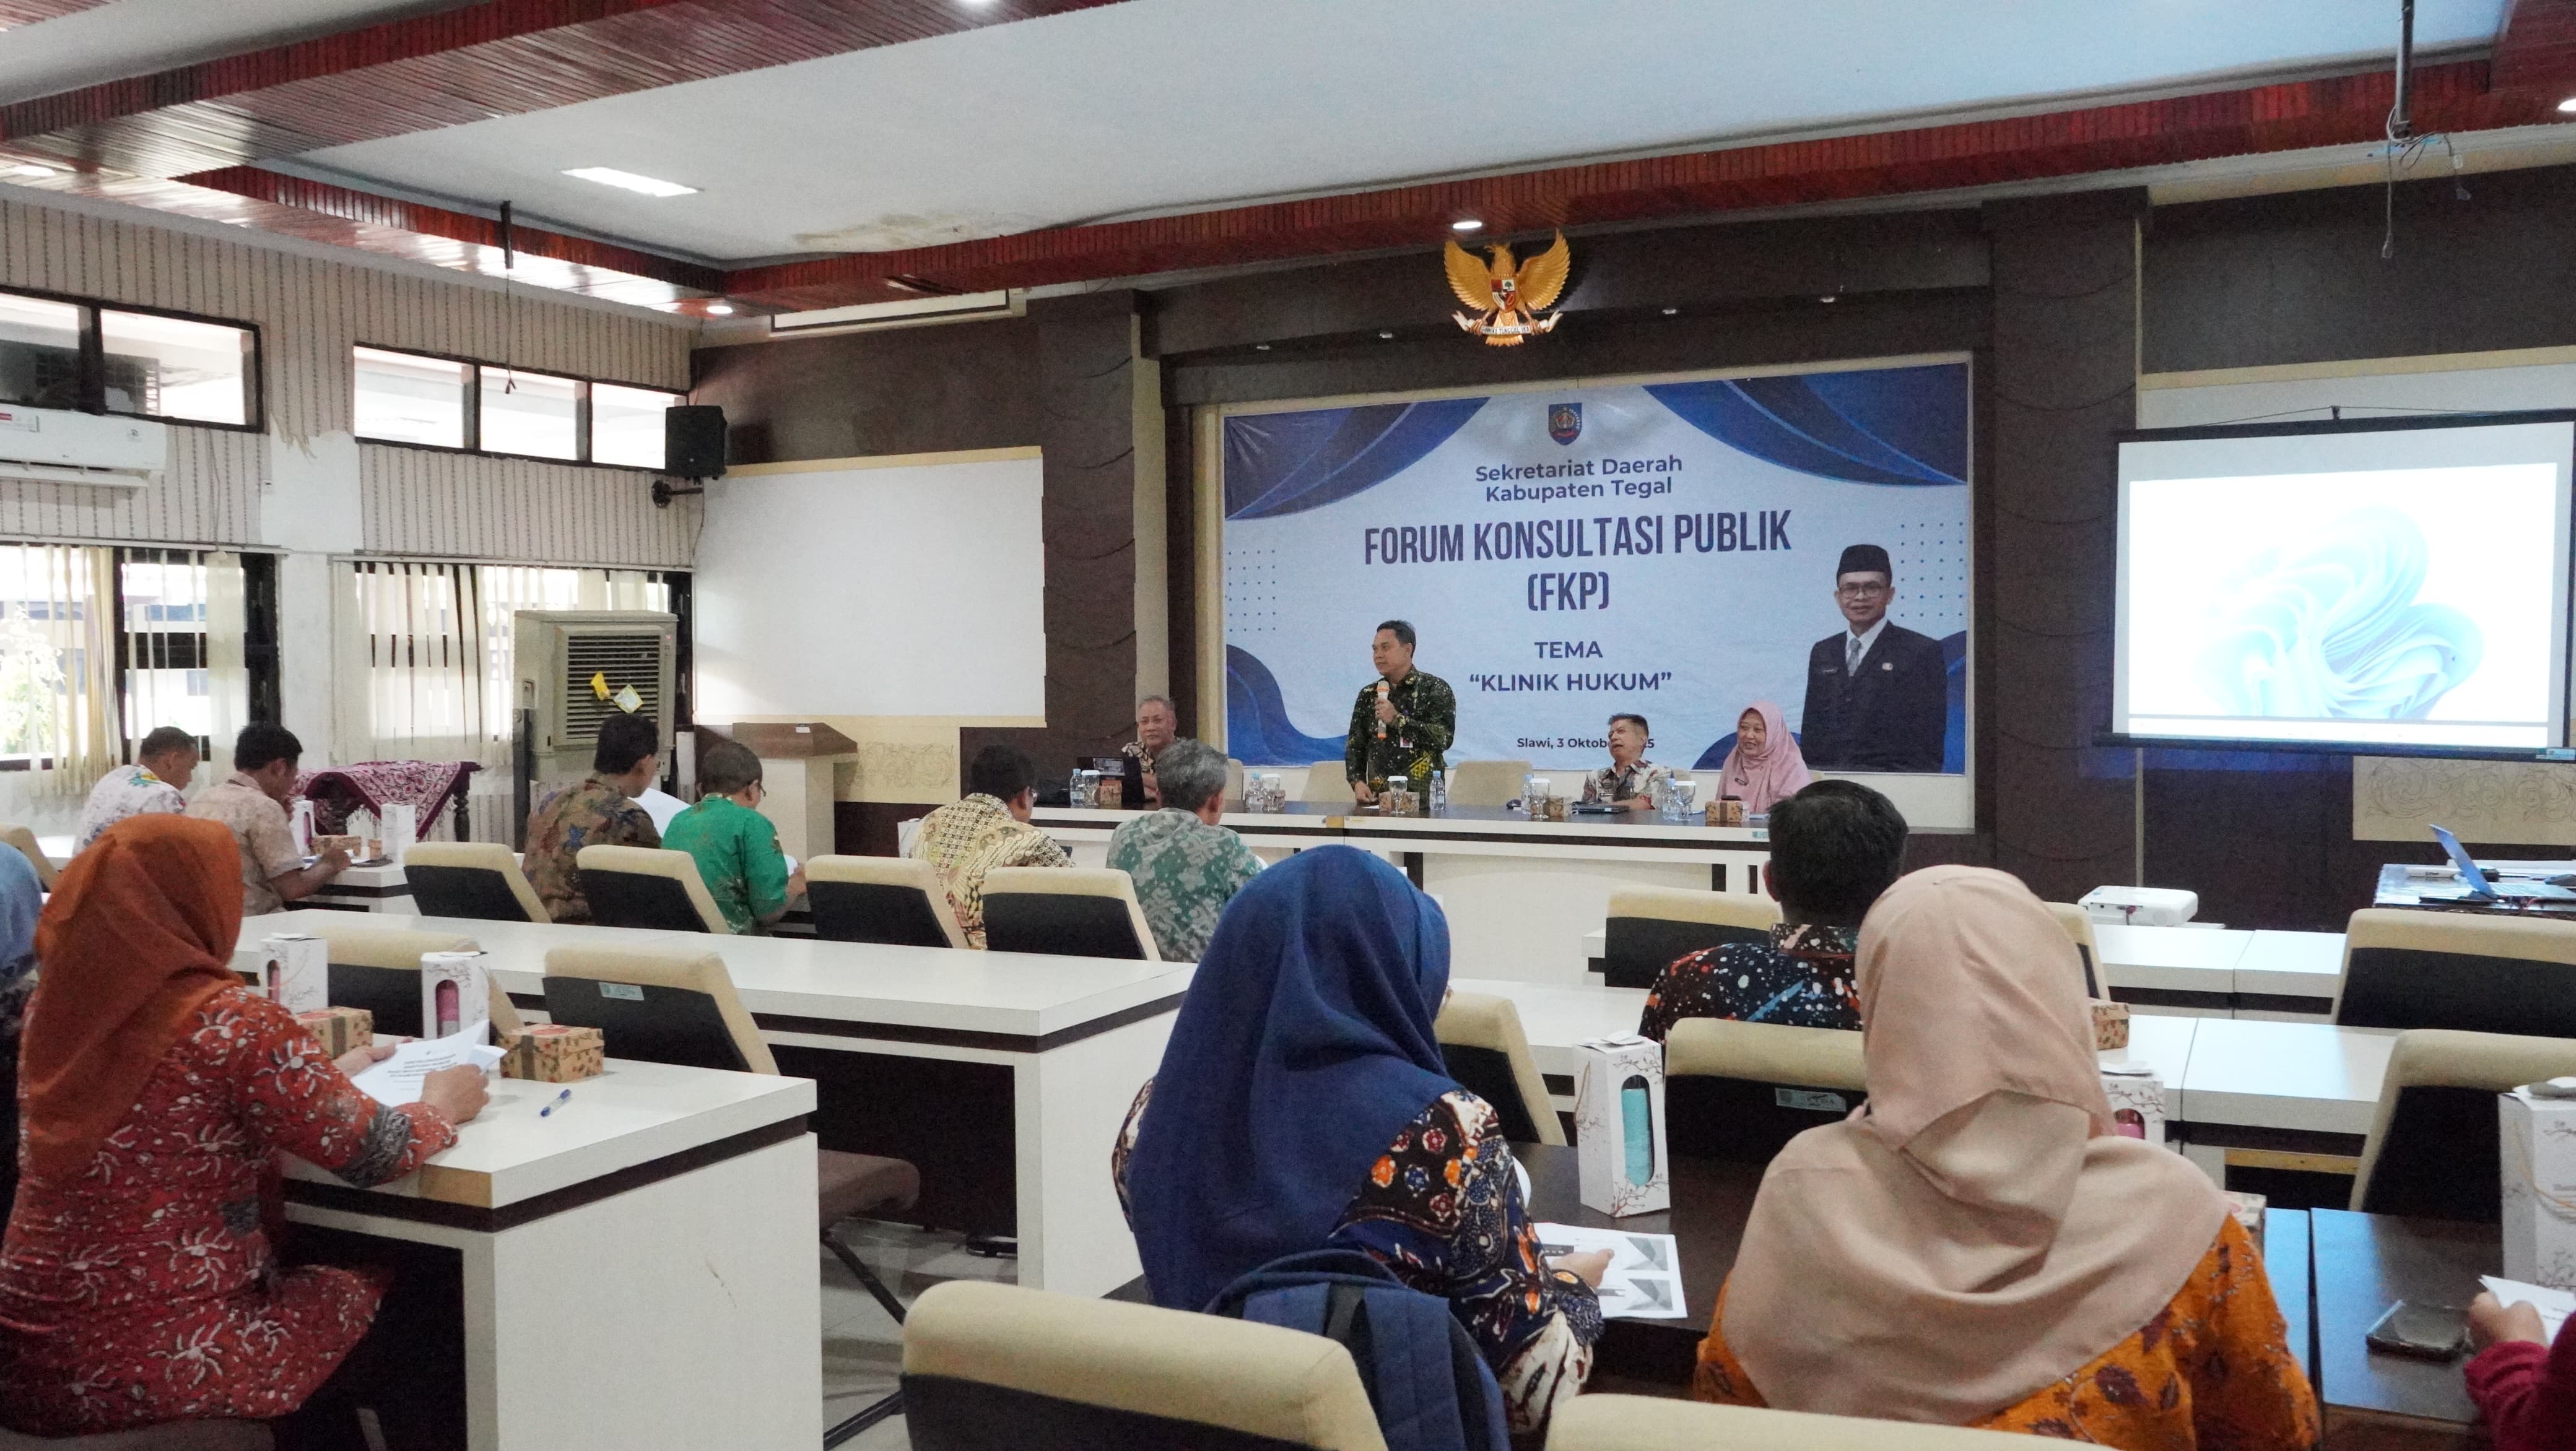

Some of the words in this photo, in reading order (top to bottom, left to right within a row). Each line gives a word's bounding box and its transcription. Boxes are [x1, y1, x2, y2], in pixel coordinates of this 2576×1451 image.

[1476, 459, 1595, 482] Sekretariat
[1603, 454, 1682, 475] Daerah
[1486, 482, 1604, 503] Kabupaten
[1611, 476, 1672, 499] Tegal
[1364, 524, 1464, 565] FORUM
[1474, 514, 1663, 561] KONSULTASI
[1674, 509, 1792, 553] PUBLIK
[1527, 571, 1610, 612] (FKP)
[1534, 641, 1604, 659] TEMA
[1469, 674, 1560, 691] “KLINIK
[1567, 672, 1672, 691] HUKUM”
[1517, 737, 1554, 749] Slawi,
[1557, 738, 1564, 748] 3
[1567, 737, 1608, 749] Oktob
